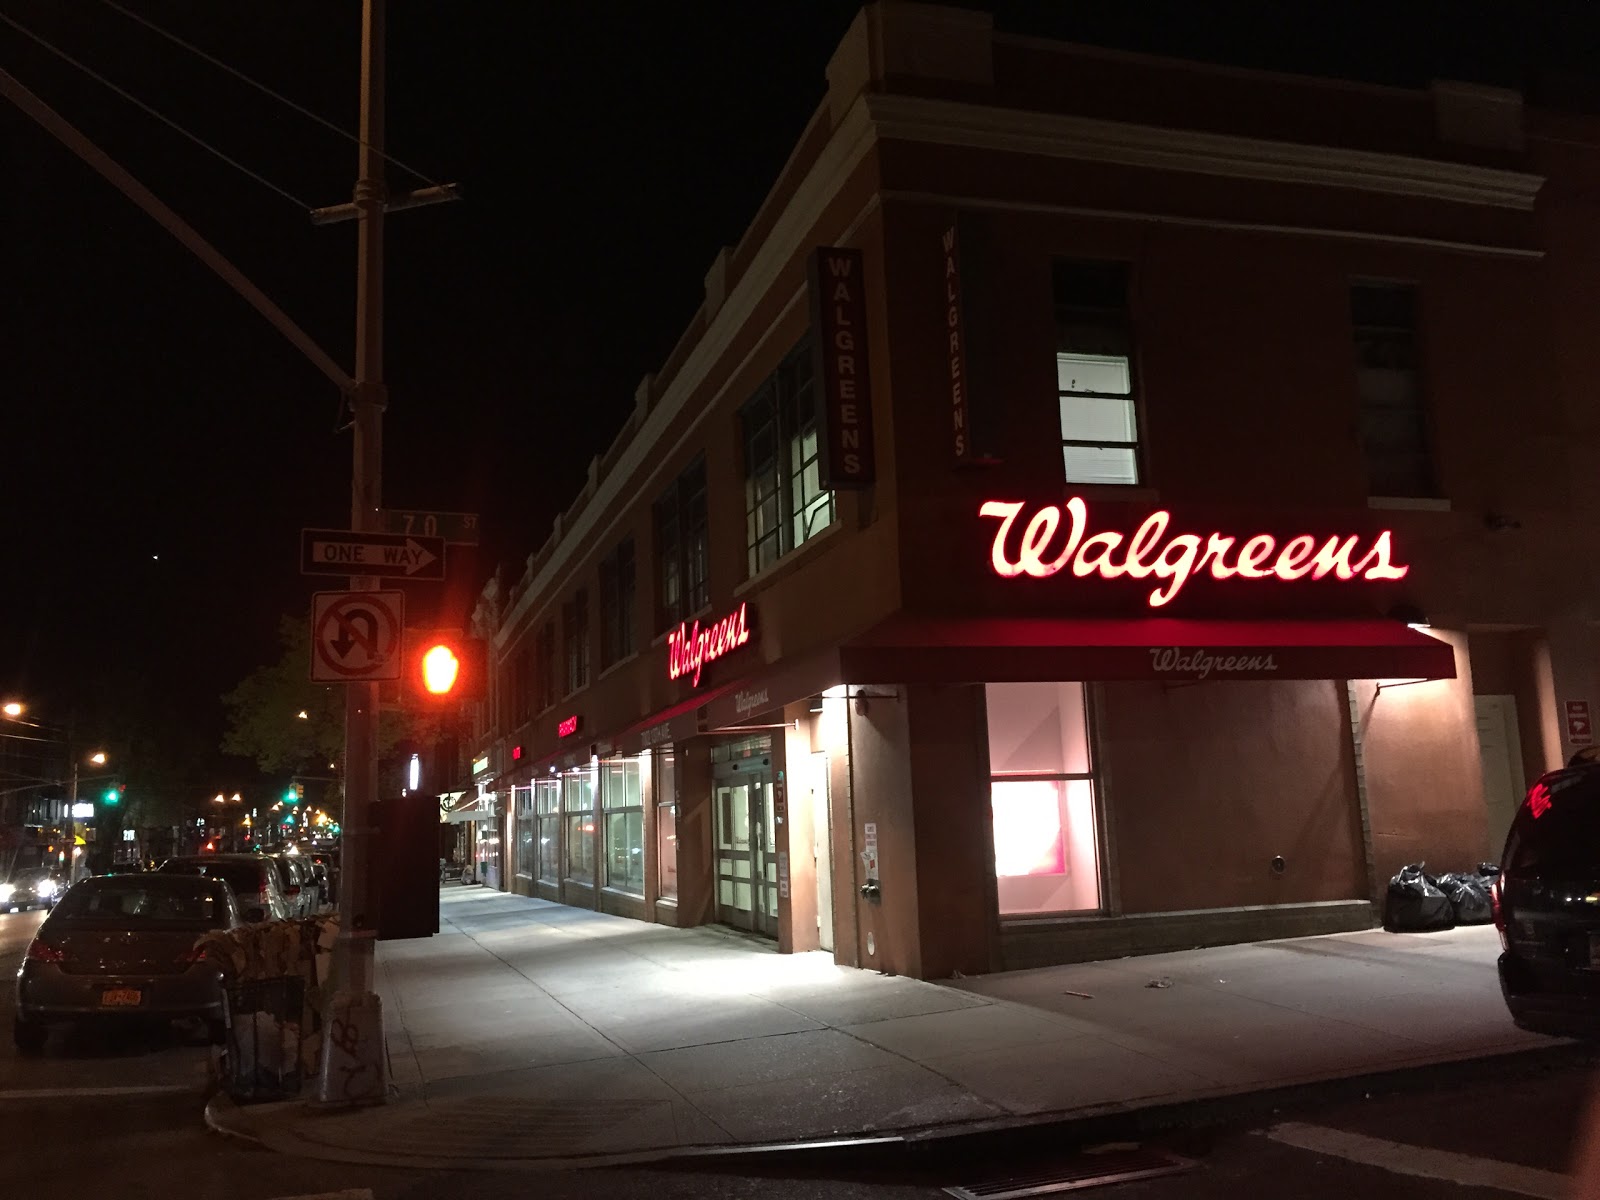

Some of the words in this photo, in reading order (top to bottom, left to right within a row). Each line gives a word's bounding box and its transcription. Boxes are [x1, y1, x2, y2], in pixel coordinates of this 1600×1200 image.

[828, 256, 861, 475] WALGREENS
[943, 225, 964, 457] WALGREENS
[324, 544, 364, 562] ONE
[384, 547, 423, 565] WAY
[463, 515, 477, 529] ST
[979, 496, 1410, 608] Walgreens
[668, 602, 750, 688] Walgreens
[1149, 646, 1278, 680] Walgreens
